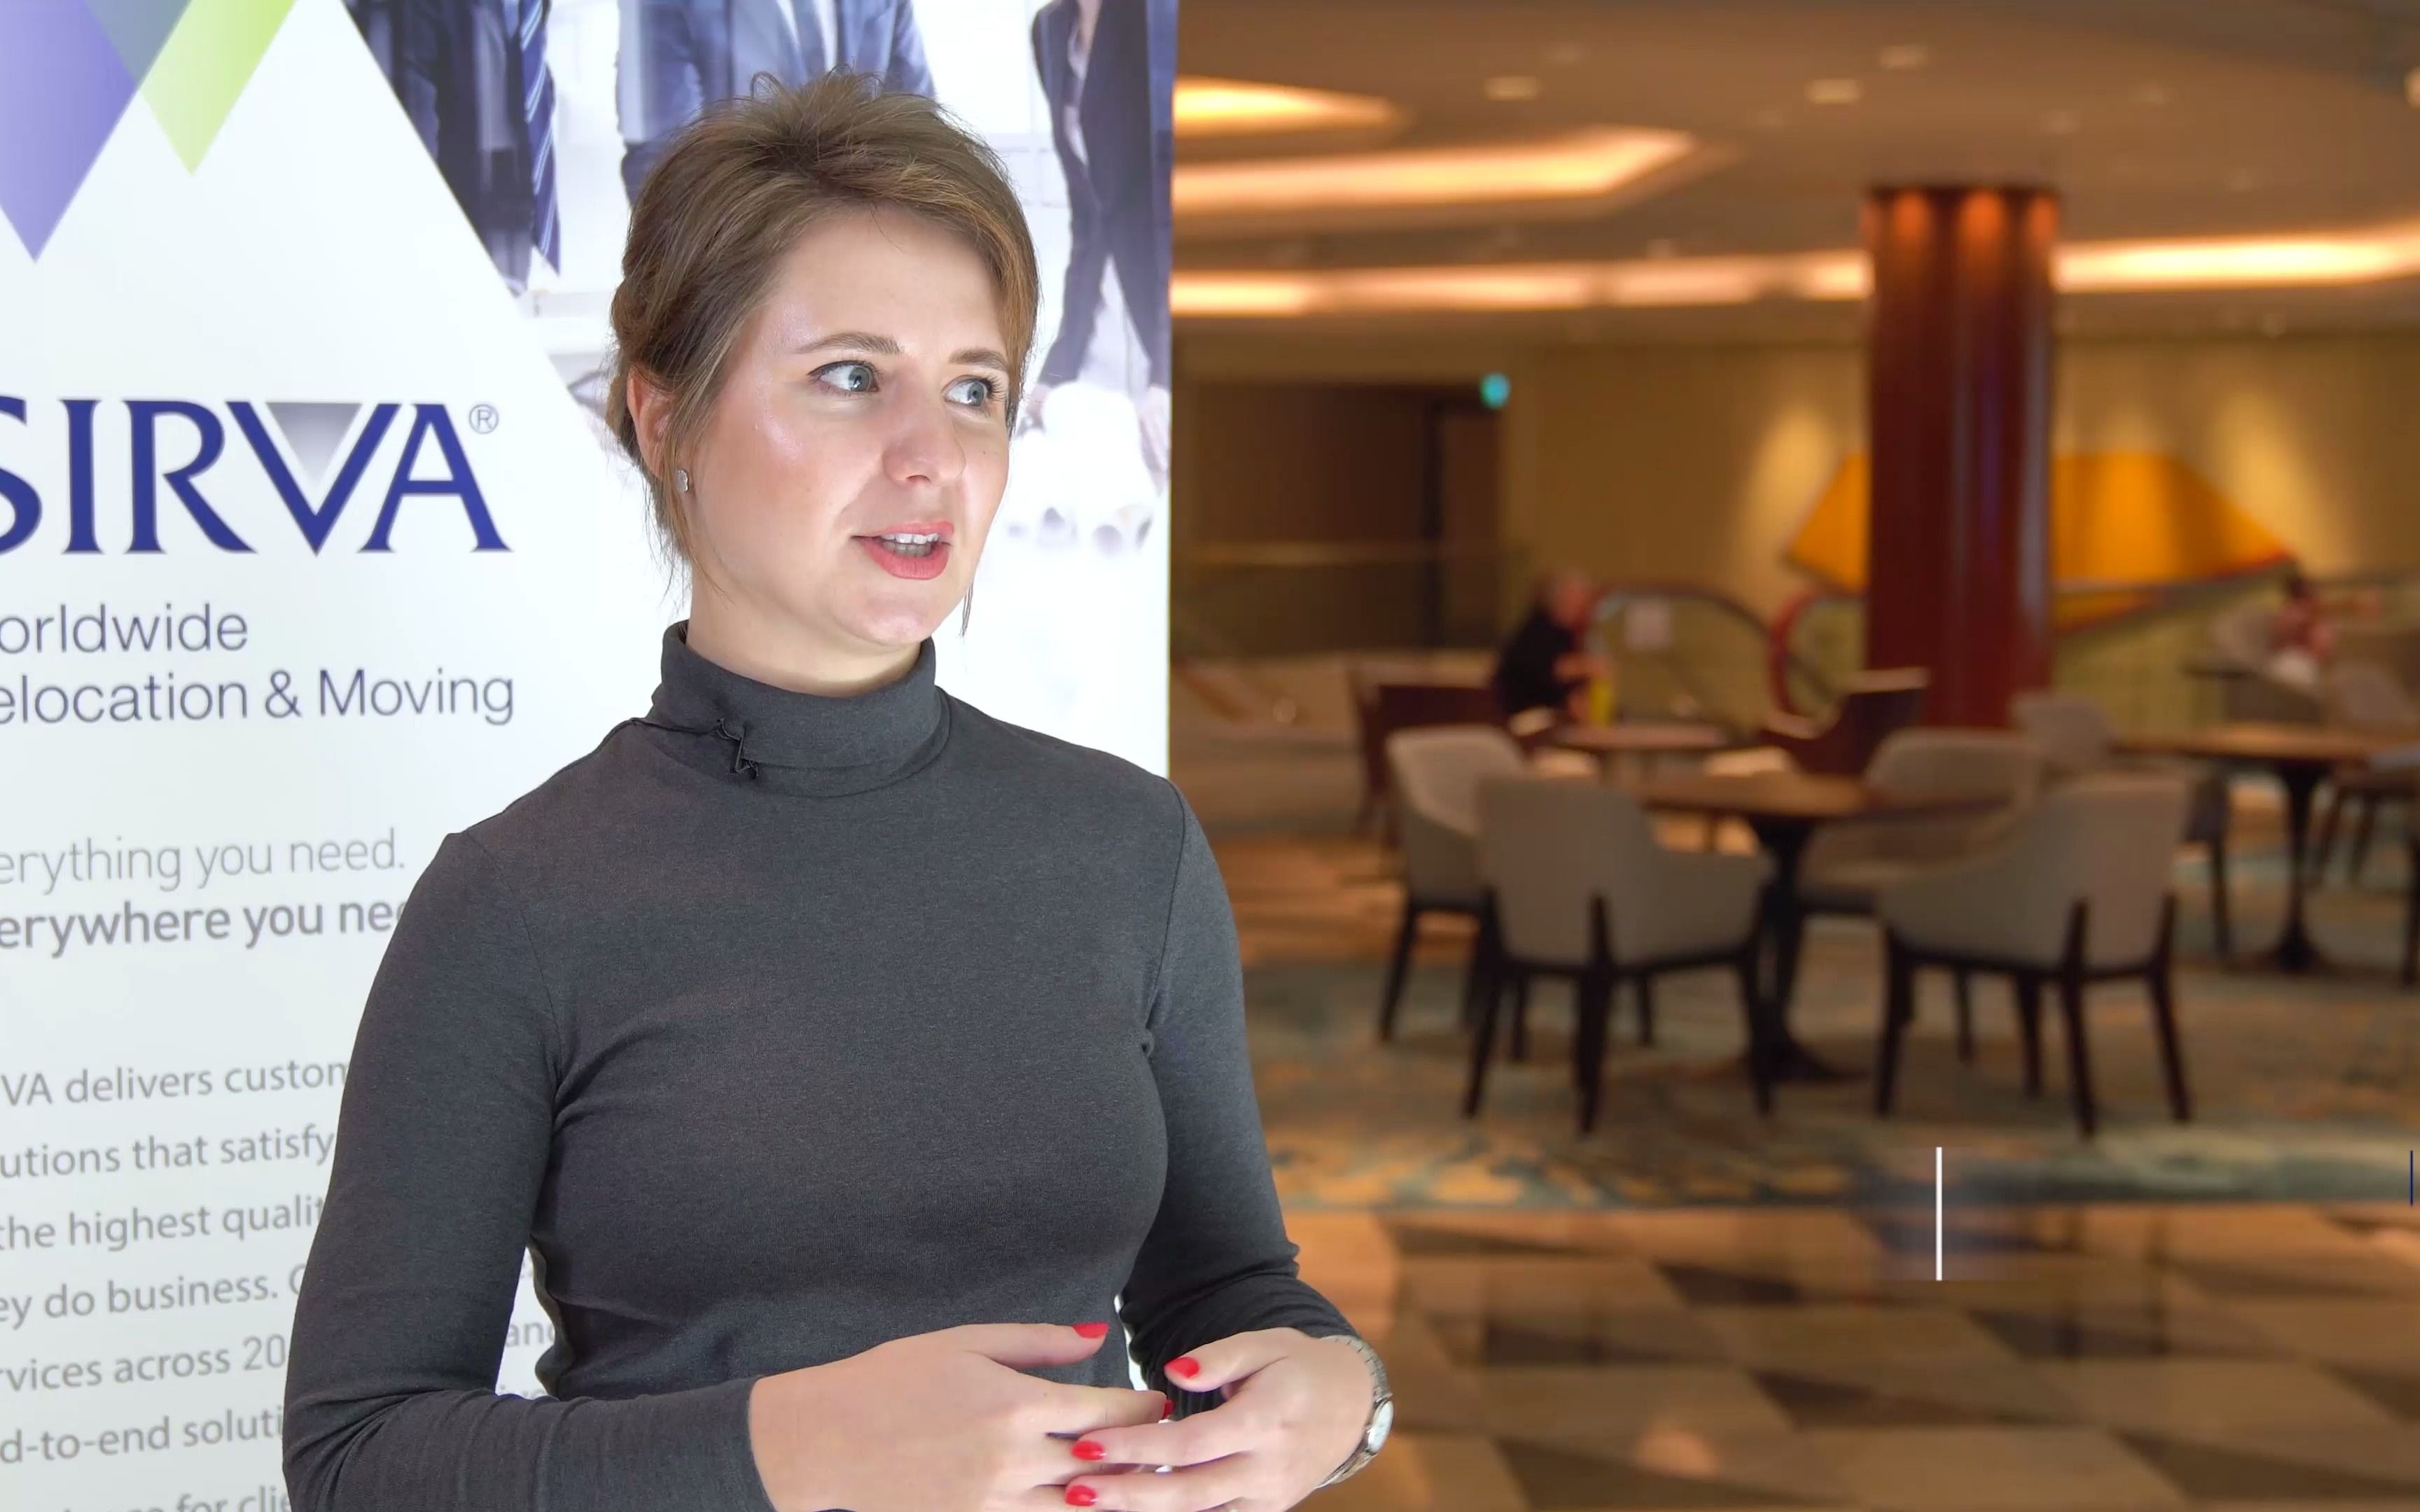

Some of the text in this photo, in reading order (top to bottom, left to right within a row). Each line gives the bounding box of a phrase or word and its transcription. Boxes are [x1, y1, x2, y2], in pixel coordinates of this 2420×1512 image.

[265, 669, 302, 718] &
[319, 667, 513, 725] Moving
[195, 844, 272, 889] you
[289, 827, 404, 872] need.
[0, 900, 230, 959] erywhere
[243, 904, 323, 949] you
[65, 1067, 213, 1103] delivers
[0, 1123, 334, 1178] utions that satisfy
[69, 1206, 211, 1252] highest
[44, 1283, 95, 1318] do
[108, 1275, 278, 1313] business.
[114, 1349, 230, 1383] across
[0, 1415, 169, 1464] d-to-end
